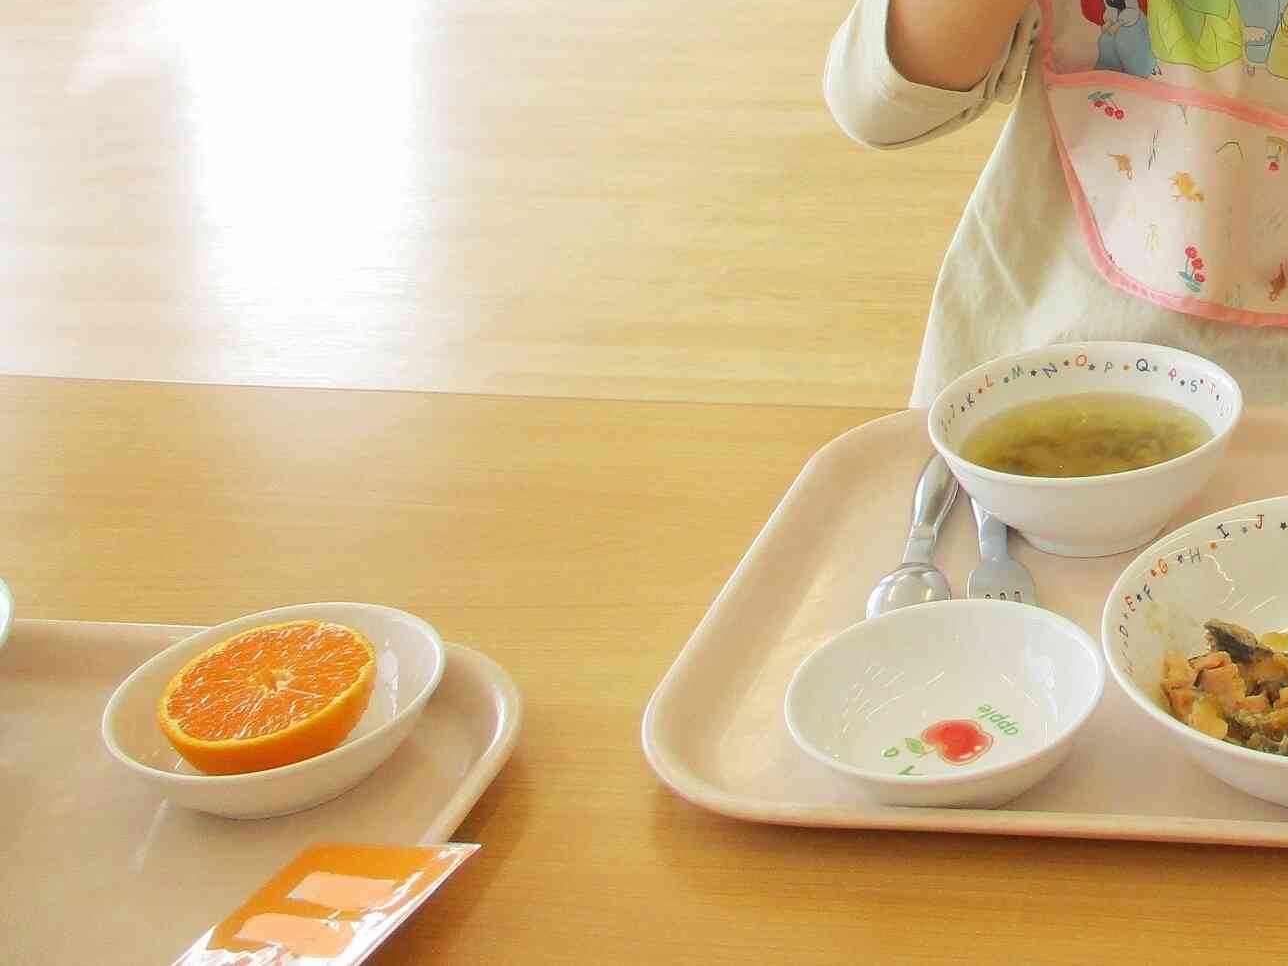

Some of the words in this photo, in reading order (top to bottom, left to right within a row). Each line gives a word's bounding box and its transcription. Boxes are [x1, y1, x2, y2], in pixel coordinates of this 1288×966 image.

[1041, 362, 1058, 379] N
[1075, 354, 1088, 367] O
[1135, 358, 1150, 372] Q
[1255, 514, 1265, 530] J
[976, 703, 1019, 735] apple
